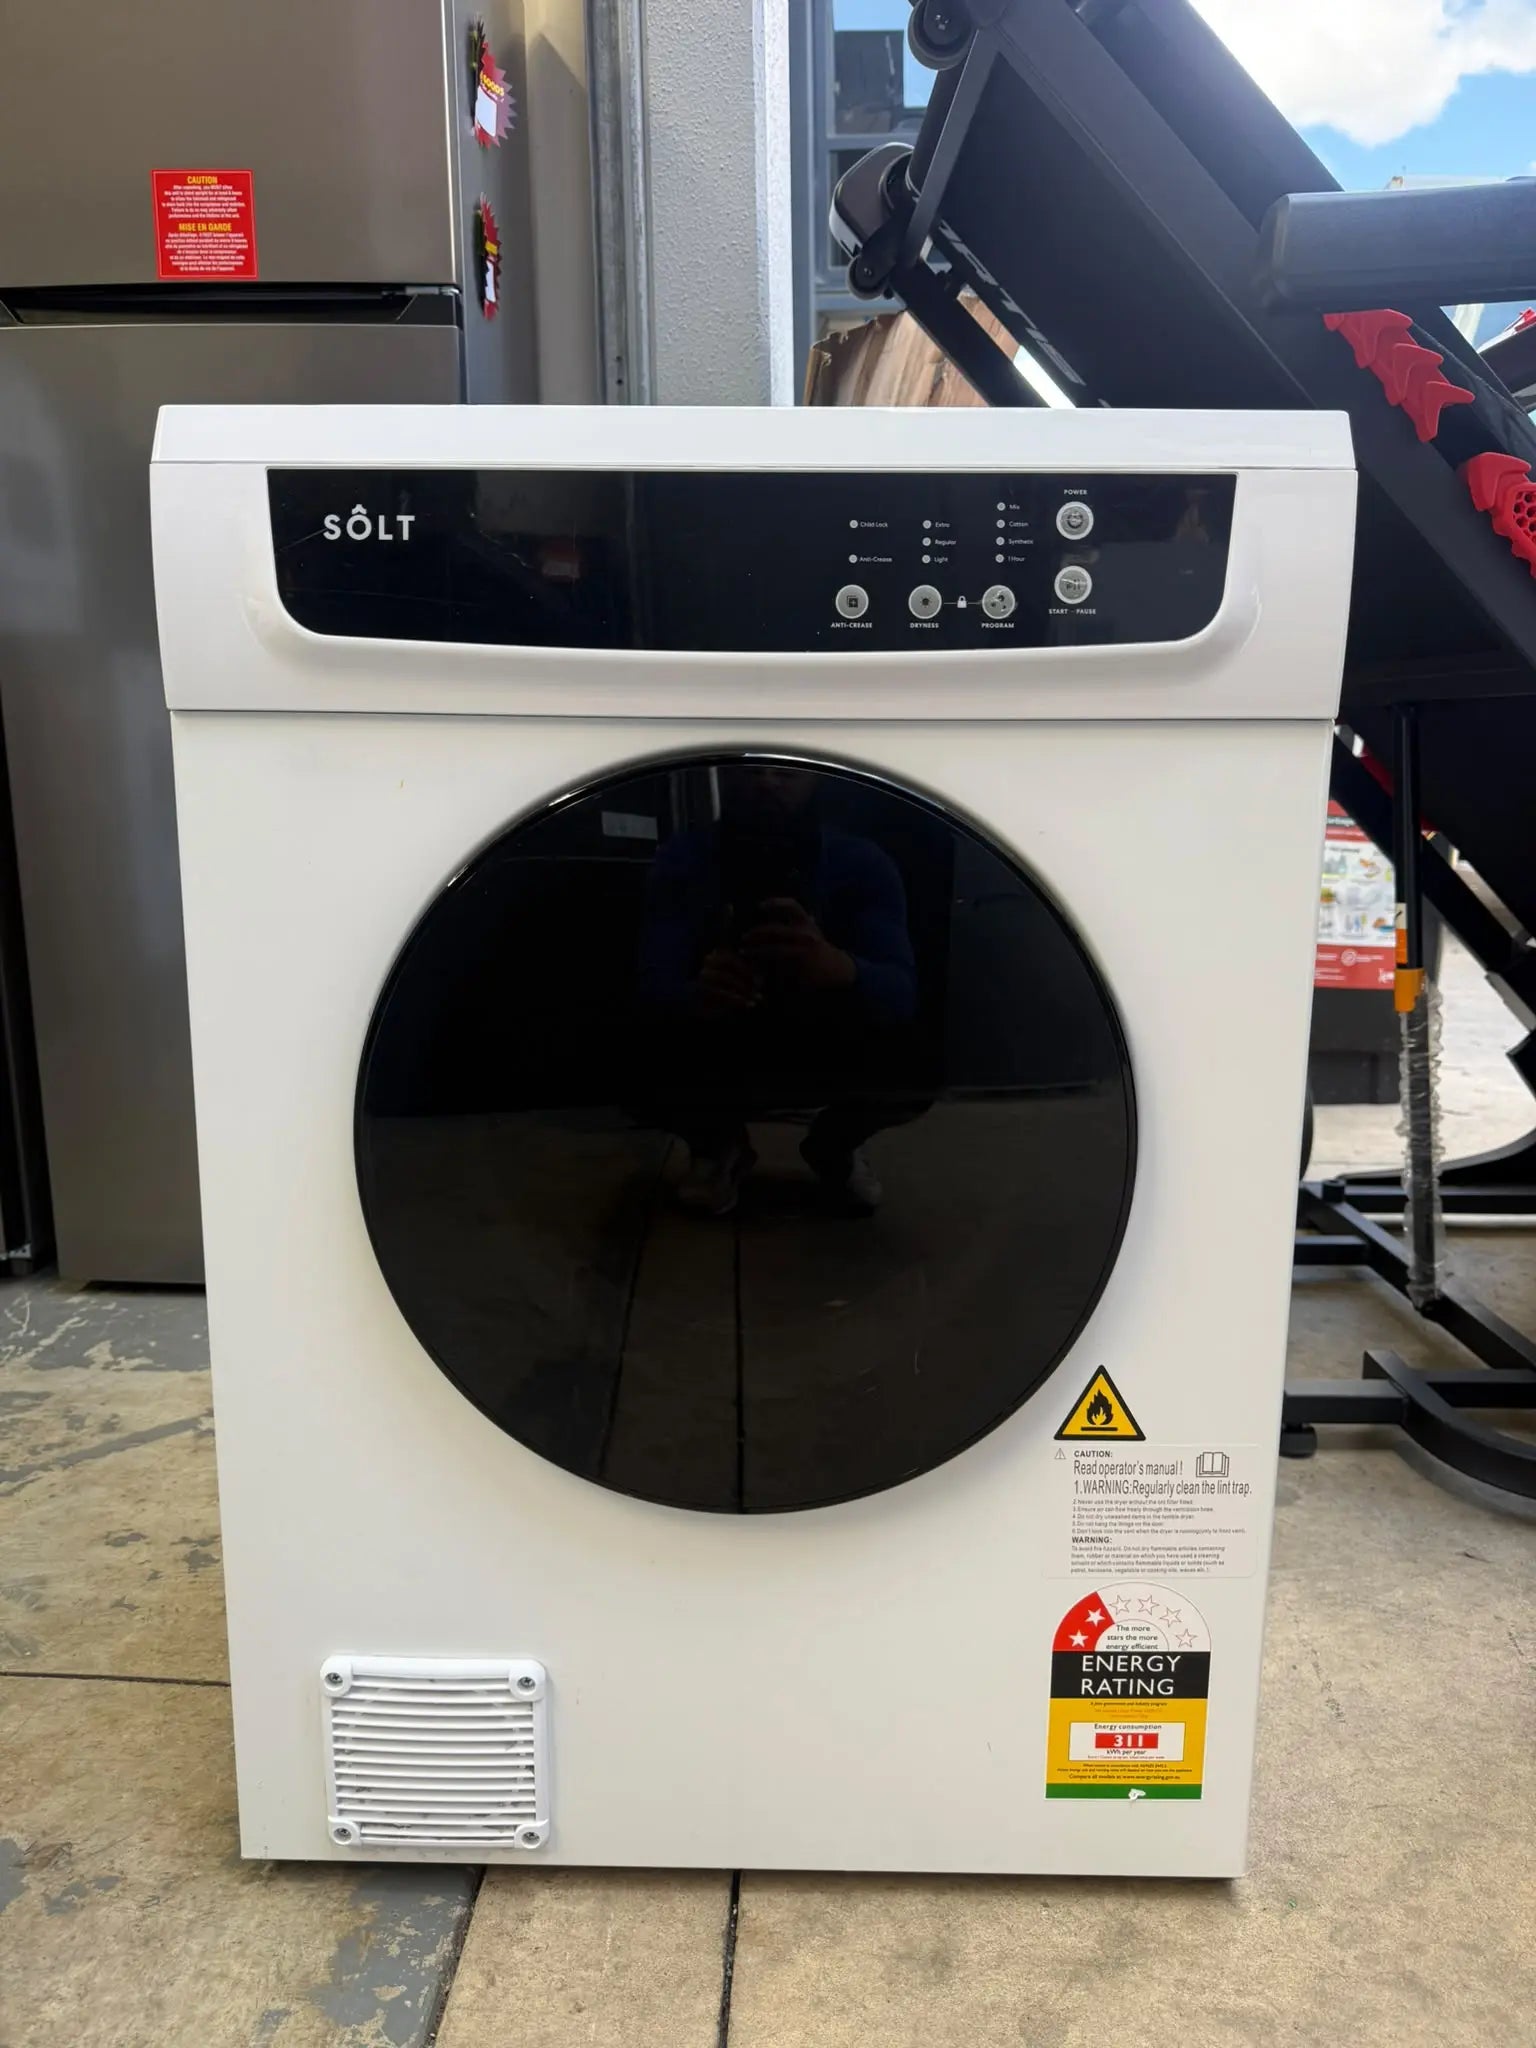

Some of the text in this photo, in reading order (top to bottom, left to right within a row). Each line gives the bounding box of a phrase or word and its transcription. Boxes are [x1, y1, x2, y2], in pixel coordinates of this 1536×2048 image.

[187, 176, 218, 184] CAUTION
[323, 504, 415, 540] SÔLT
[1074, 1460, 1097, 1475] Read
[1176, 1480, 1199, 1495] clean
[1202, 1480, 1215, 1495] the
[1217, 1480, 1230, 1495] lint
[1232, 1480, 1252, 1497] trap.
[1082, 1655, 1181, 1672] ENERGY
[1081, 1678, 1174, 1695] RATING
[1114, 1735, 1143, 1747] 311
